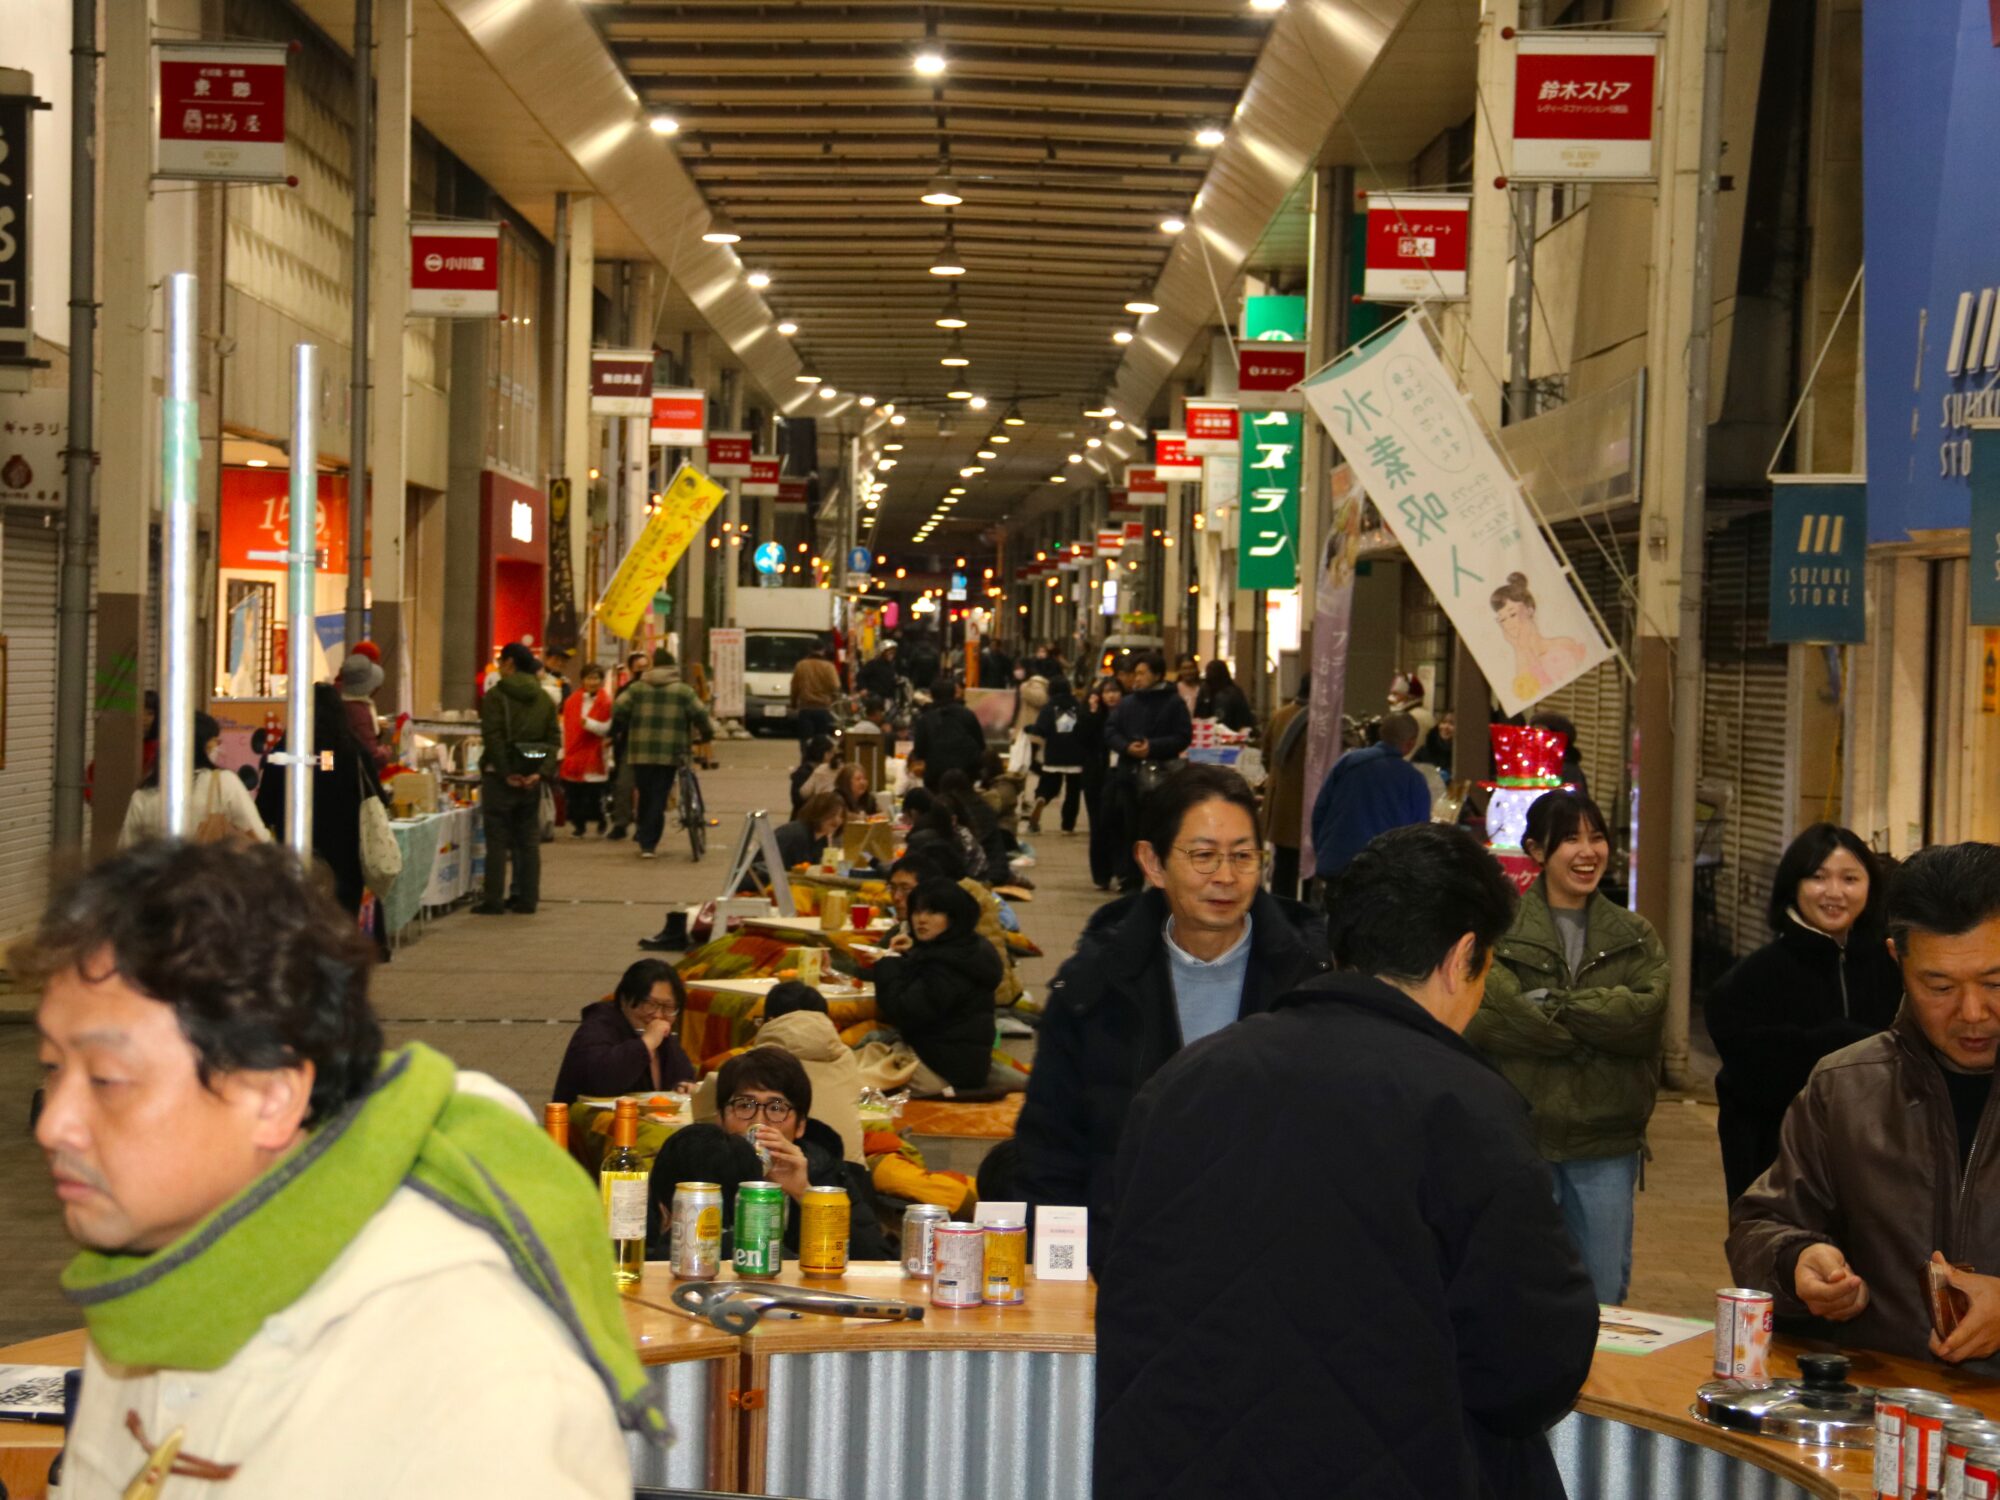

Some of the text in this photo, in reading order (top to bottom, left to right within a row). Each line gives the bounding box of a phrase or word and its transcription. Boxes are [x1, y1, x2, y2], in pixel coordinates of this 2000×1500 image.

[1537, 80, 1632, 101] 鈴木ストア
[1940, 440, 1971, 476] STO
[1790, 567, 1851, 585] SUZUKI
[1789, 587, 1850, 606] STORE
